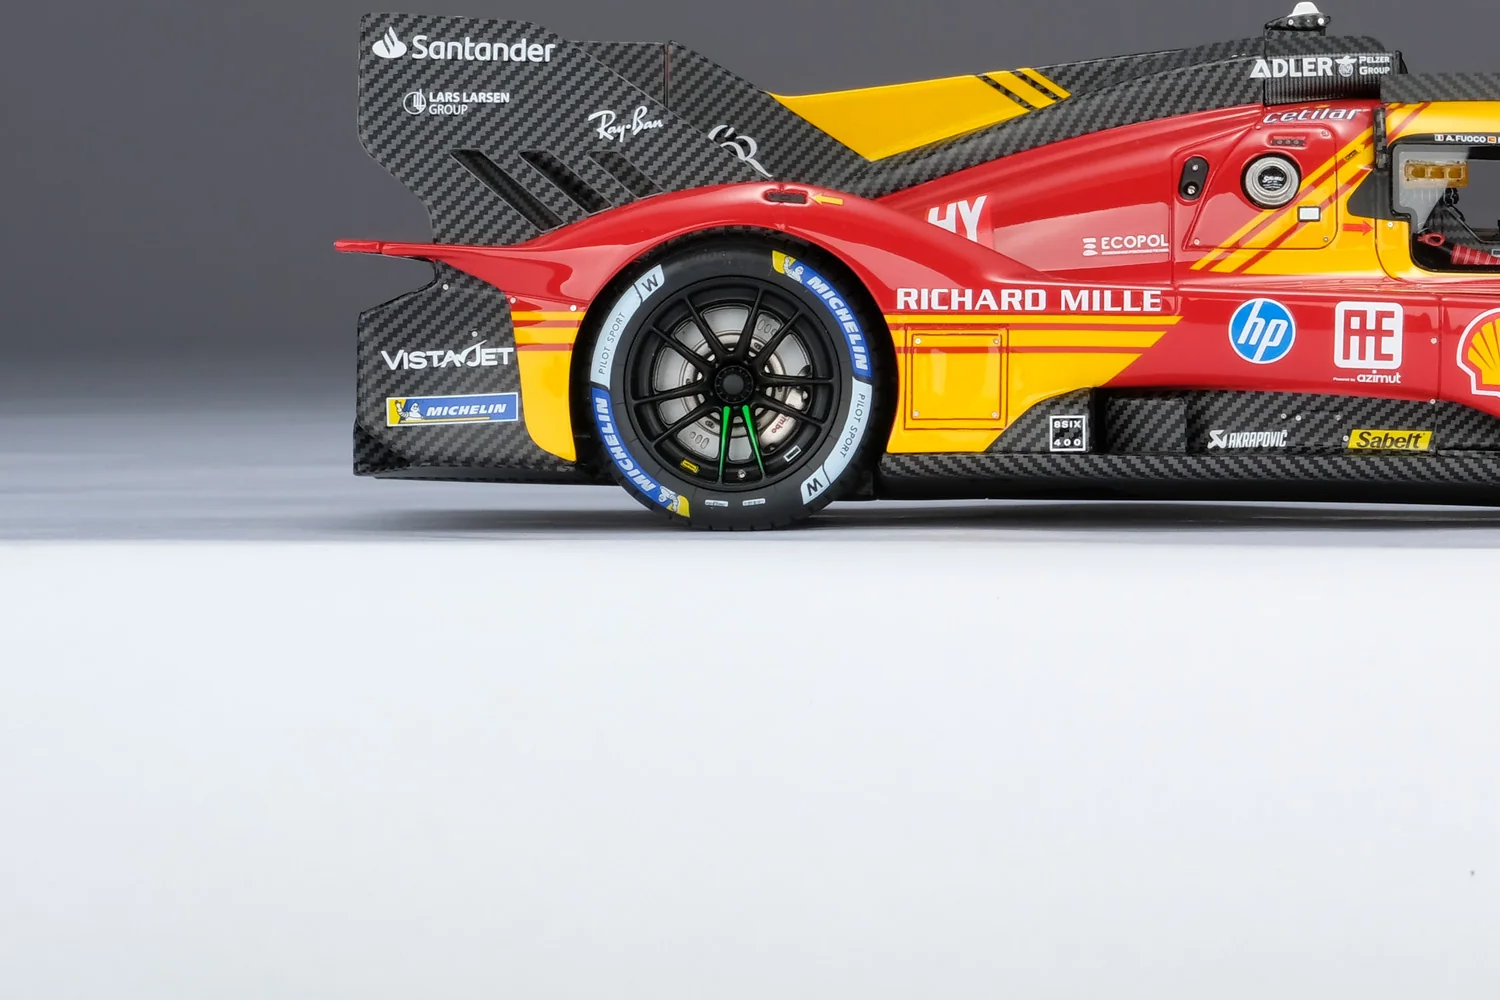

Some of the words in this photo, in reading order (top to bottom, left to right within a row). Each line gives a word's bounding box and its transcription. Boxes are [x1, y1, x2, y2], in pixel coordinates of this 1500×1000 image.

[412, 35, 556, 62] Santander
[1250, 57, 1333, 78] ADLER
[1359, 66, 1390, 75] GROUP
[429, 92, 461, 104] LARS
[463, 92, 510, 104] LARSEN
[429, 104, 468, 116] GROUP
[1263, 108, 1363, 123] cetilar
[1455, 135, 1487, 143] FUOCO
[1101, 233, 1169, 249] ECOPOL
[896, 288, 1047, 311] RICHARD
[1060, 289, 1162, 312] MILLE
[605, 311, 627, 343] SPORT
[807, 276, 869, 370] MICHELIN
[1237, 300, 1289, 361] hp
[381, 340, 515, 371] VISTAJET
[598, 346, 613, 376] PILOT
[1356, 369, 1402, 384] azimut
[425, 403, 507, 419] MICHELIN
[853, 393, 866, 423] PILOT
[1053, 420, 1082, 429] 8SIX
[594, 397, 658, 492] MICHELIN
[839, 425, 858, 458] SPORT
[1053, 438, 1082, 447] 400
[1356, 431, 1422, 449] Sabelt
